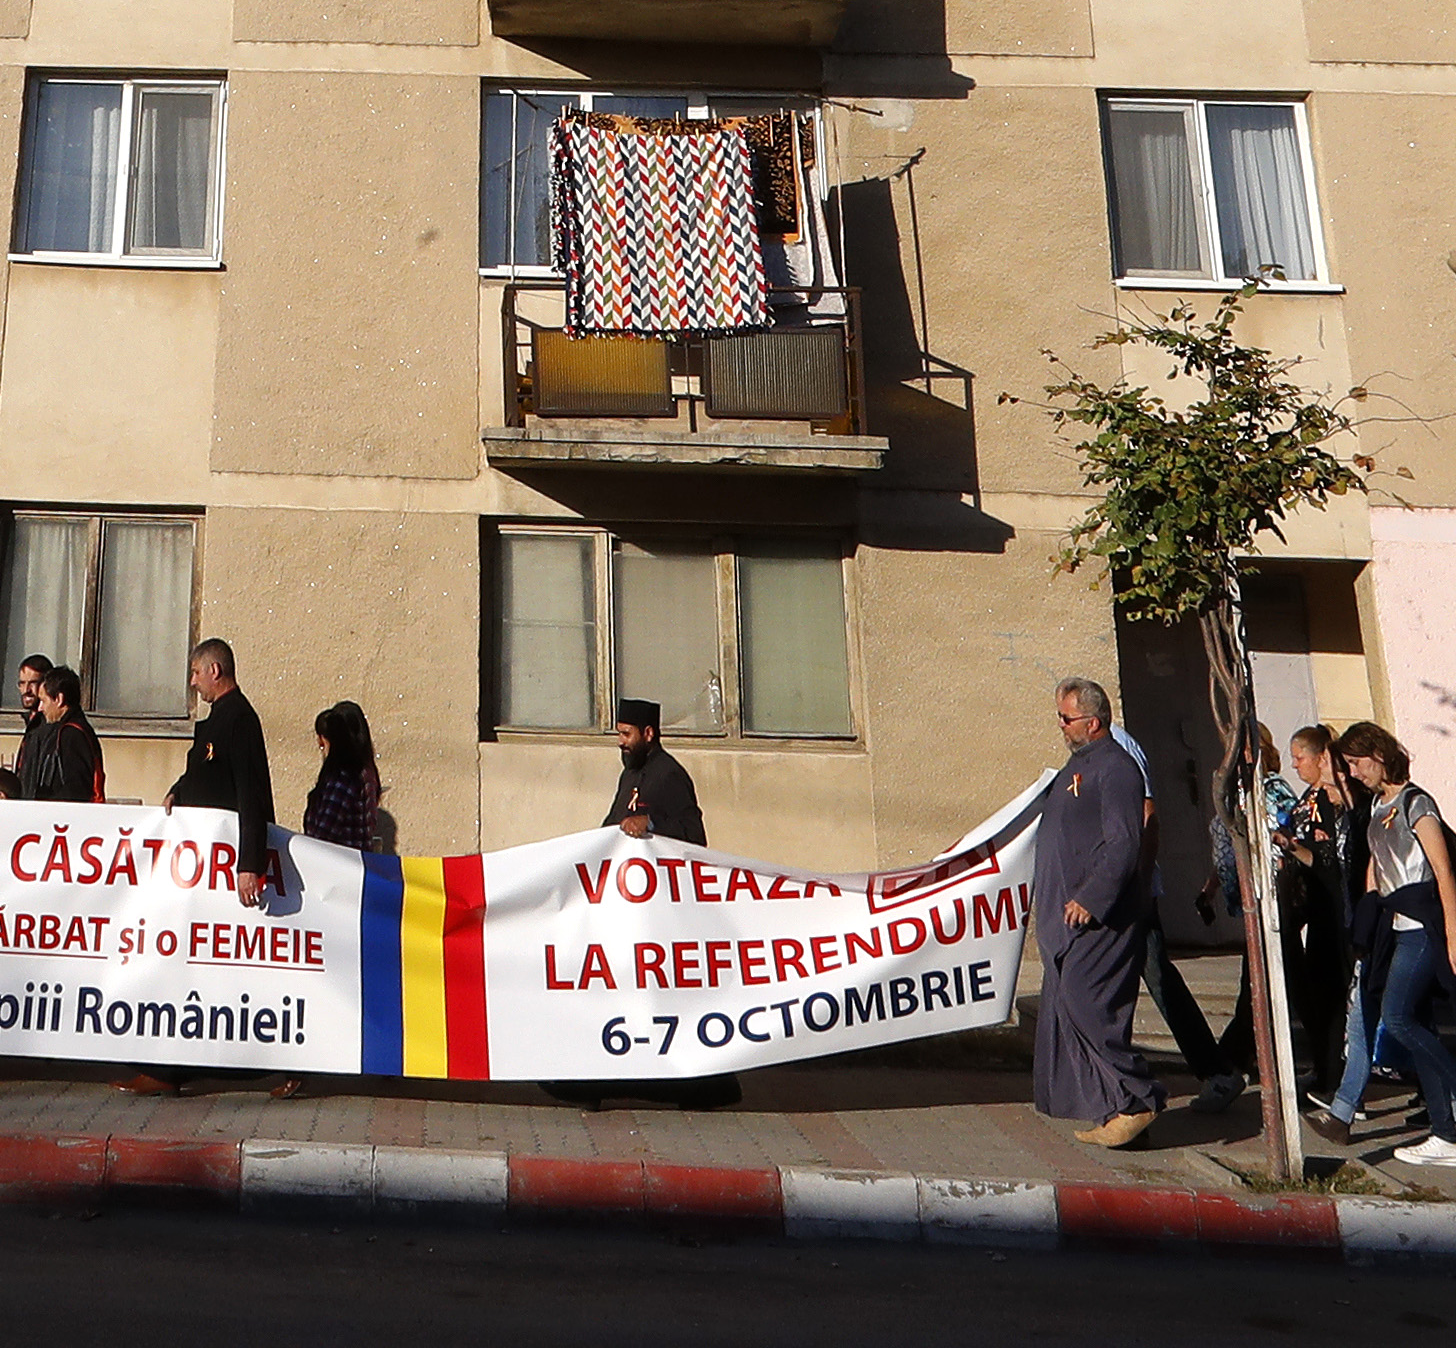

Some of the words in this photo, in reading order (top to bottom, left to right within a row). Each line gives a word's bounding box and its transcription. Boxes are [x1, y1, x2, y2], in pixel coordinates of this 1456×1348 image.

[11, 825, 286, 898] CĂSĂTORA
[119, 919, 146, 965] și
[157, 929, 178, 957] o
[190, 922, 324, 966] FEMEIE
[546, 943, 617, 990] LA
[635, 883, 1029, 989] REFERENDUM!
[75, 986, 305, 1045] României!
[601, 1016, 679, 1056] 6-7
[696, 960, 996, 1048] OCTOMBRIE
